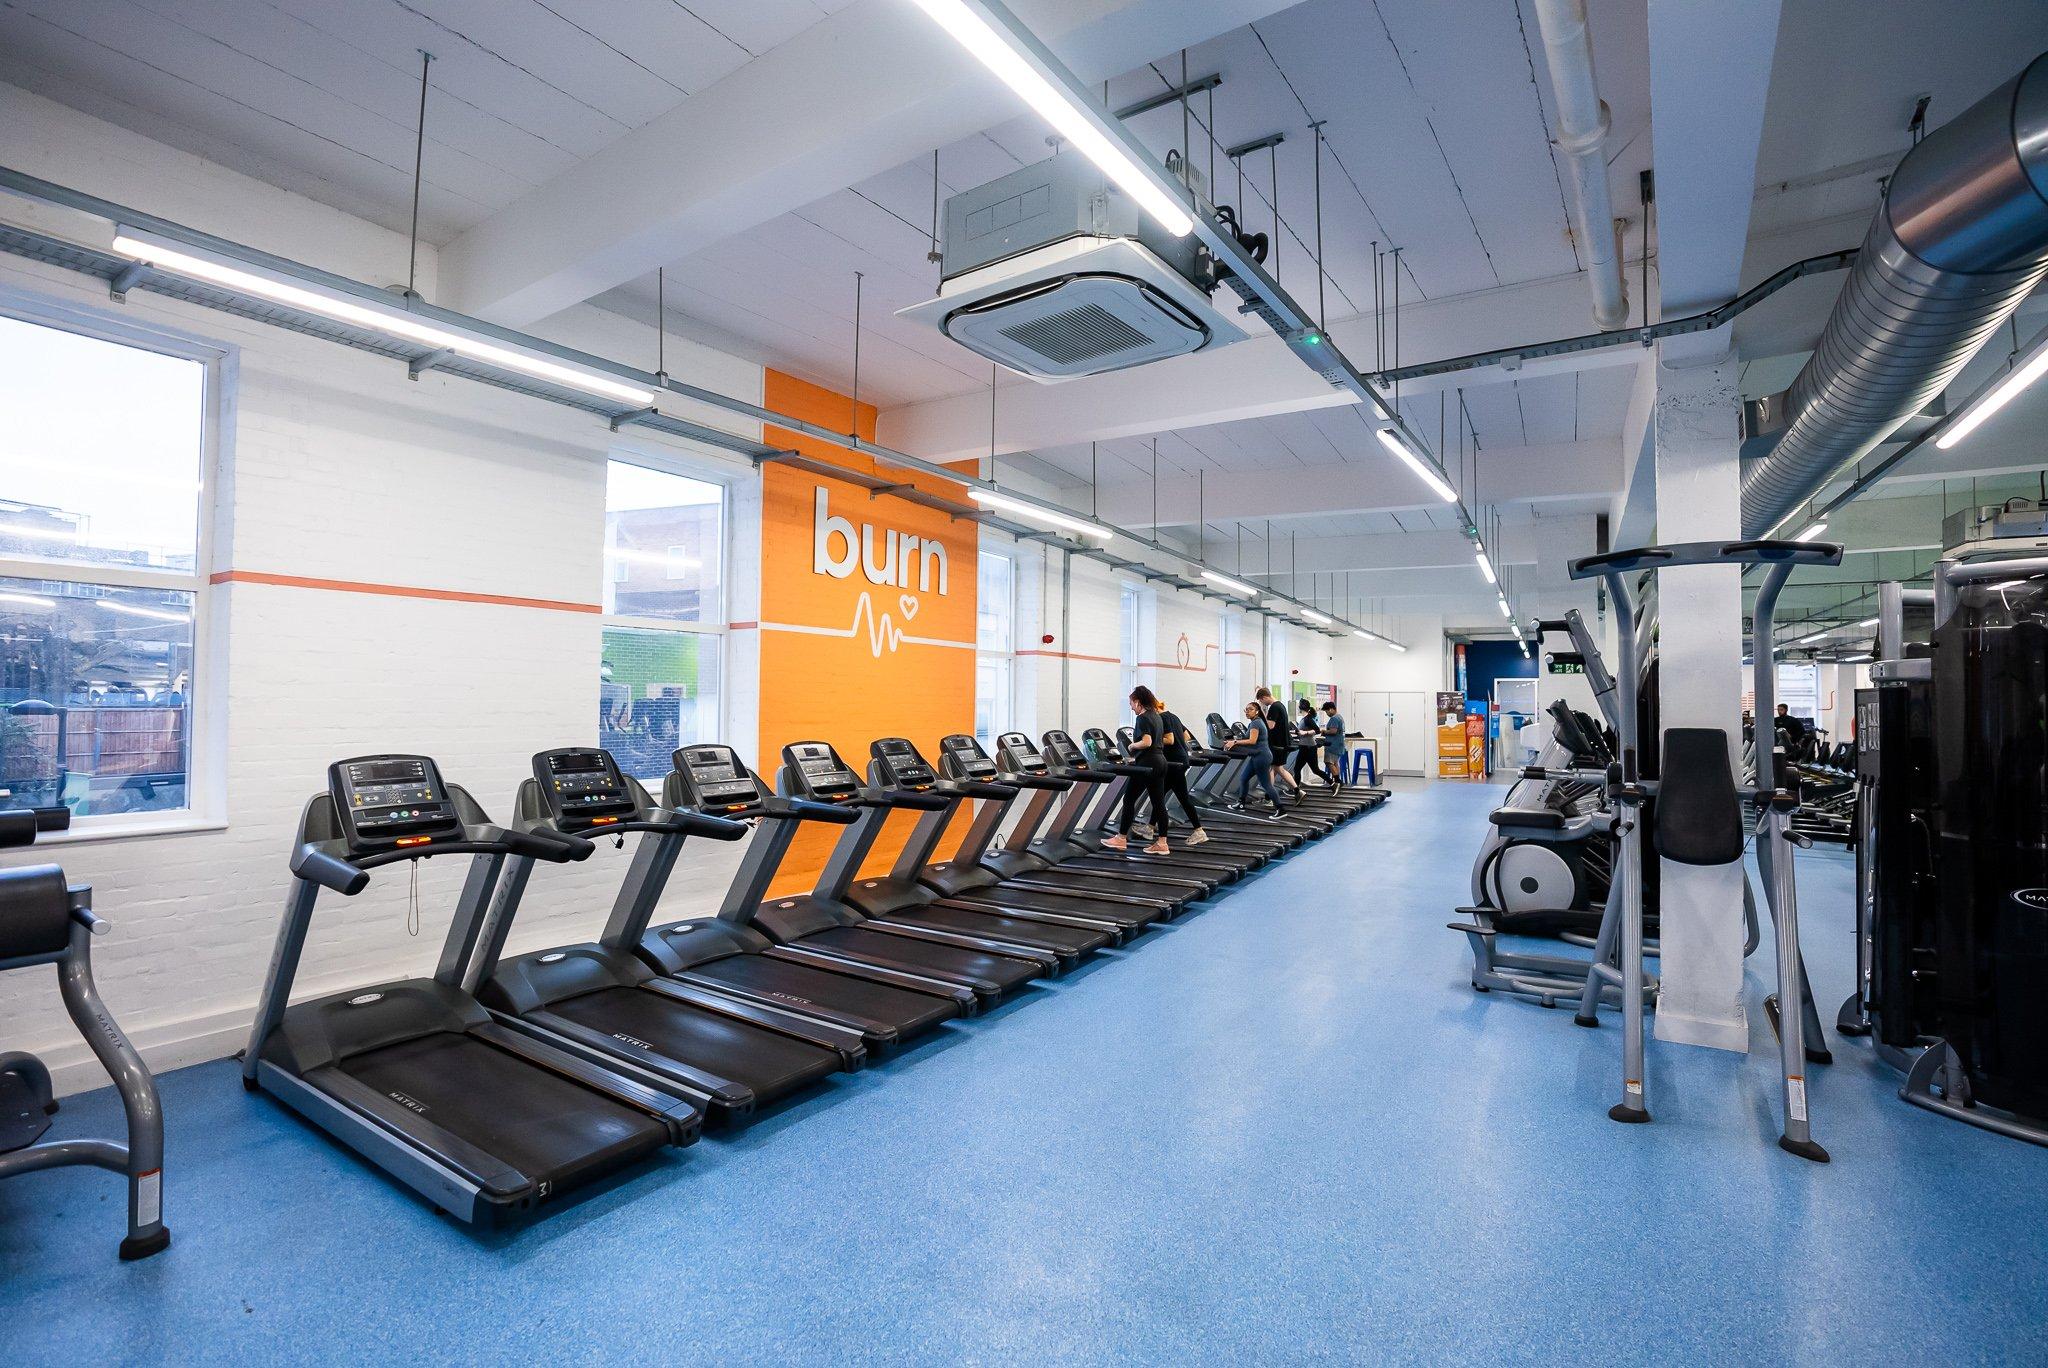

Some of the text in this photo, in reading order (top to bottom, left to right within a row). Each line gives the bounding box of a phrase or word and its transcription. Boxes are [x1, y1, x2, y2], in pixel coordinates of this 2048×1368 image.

[813, 485, 948, 595] burn
[481, 866, 514, 951] MATRIX
[95, 1013, 124, 1049] MATRIX
[613, 1033, 650, 1050] MATRIX
[388, 1091, 426, 1113] MATRIX
